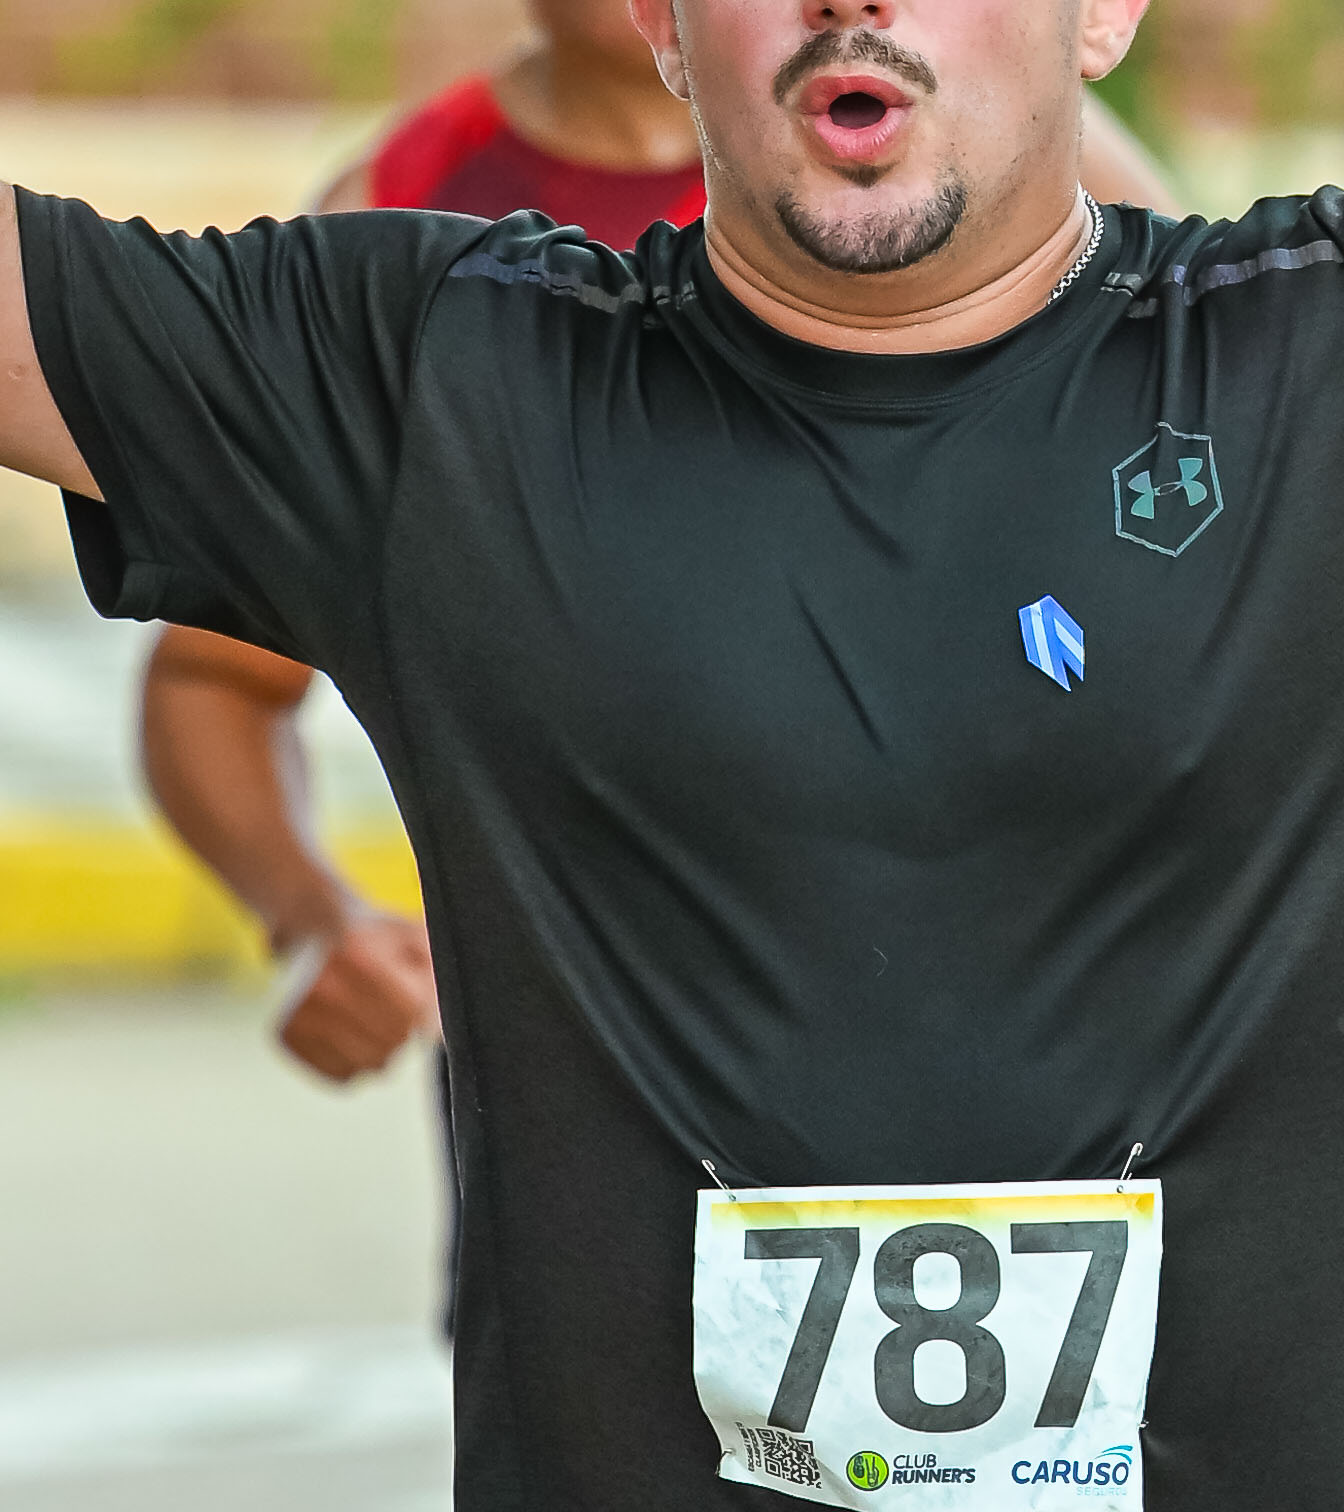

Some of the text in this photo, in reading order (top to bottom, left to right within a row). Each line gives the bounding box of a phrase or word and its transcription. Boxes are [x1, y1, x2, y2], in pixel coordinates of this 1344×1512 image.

[744, 1220, 1130, 1434] 787
[893, 1454, 937, 1469] CLUB
[1011, 1459, 1130, 1486] CARUSO
[891, 1467, 976, 1485] RUNNER'S
